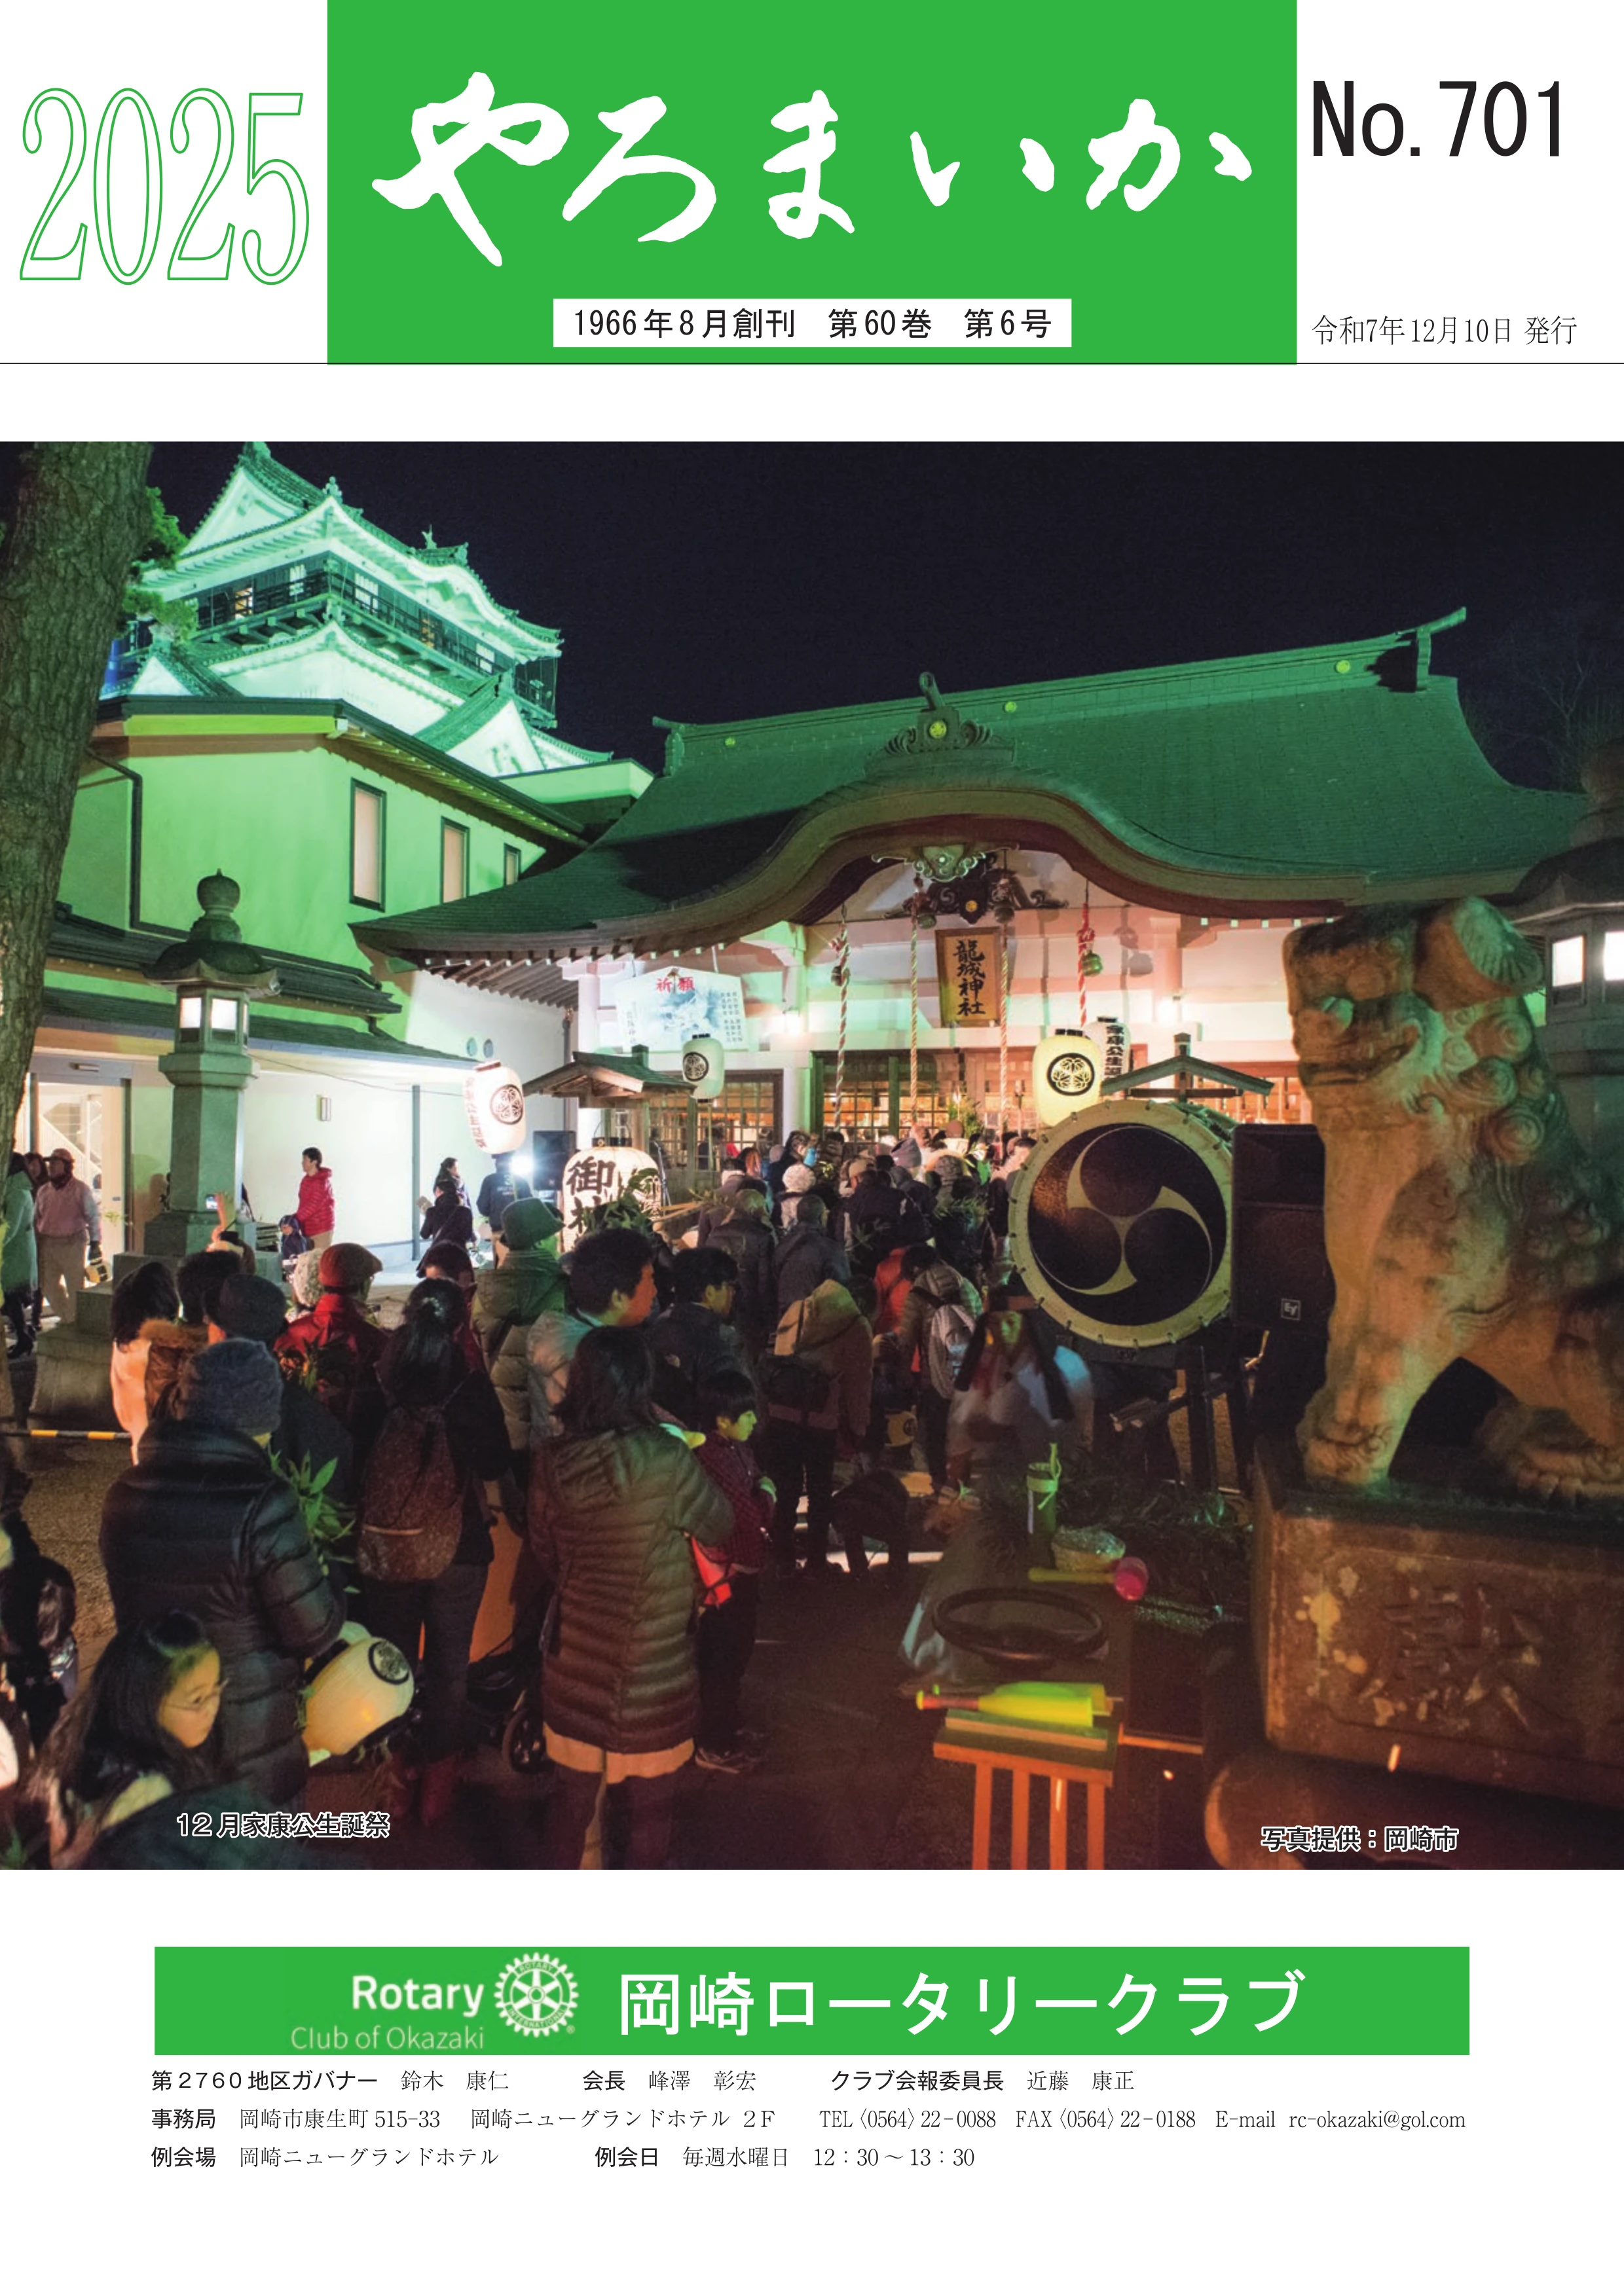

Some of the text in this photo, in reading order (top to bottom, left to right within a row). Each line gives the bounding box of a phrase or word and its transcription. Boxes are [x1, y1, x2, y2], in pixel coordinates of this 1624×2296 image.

[372, 72, 1252, 266] やろまいか
[20, 88, 309, 285] 2025
[576, 308, 1051, 338] 1966年8月創刊 第60巻 第6号
[1312, 315, 1577, 346] 令和7年12月10日 発行
[656, 976, 695, 993] 祈願
[953, 939, 986, 1016] 龍城神社
[352, 1975, 485, 2017] Rotary
[621, 1969, 1305, 2036] 岡崎ロータリークラブ
[291, 2024, 483, 2049] Club of Okazaki
[152, 2069, 509, 2091] 第2760地区ガバナー 鈴木 康仁
[583, 2069, 756, 2091] 会長 峰澤 彰宏
[831, 2069, 1134, 2091] クラブ会報委員長 近藤 康正
[151, 2108, 215, 2129] 事務局
[471, 2108, 729, 2129] 岡崎ニューグランドホテル
[744, 2110, 775, 2128] 2F
[820, 2110, 853, 2128] TEL
[1016, 2110, 1052, 2128] FAX
[1216, 2110, 1466, 2131] E-mail rc-okazaki@gol.com
[151, 2147, 499, 2168] 例会場 岡崎ニューグランドホテル
[595, 2147, 657, 2168] 例会日
[683, 2147, 787, 2168] 毎週水曜日
